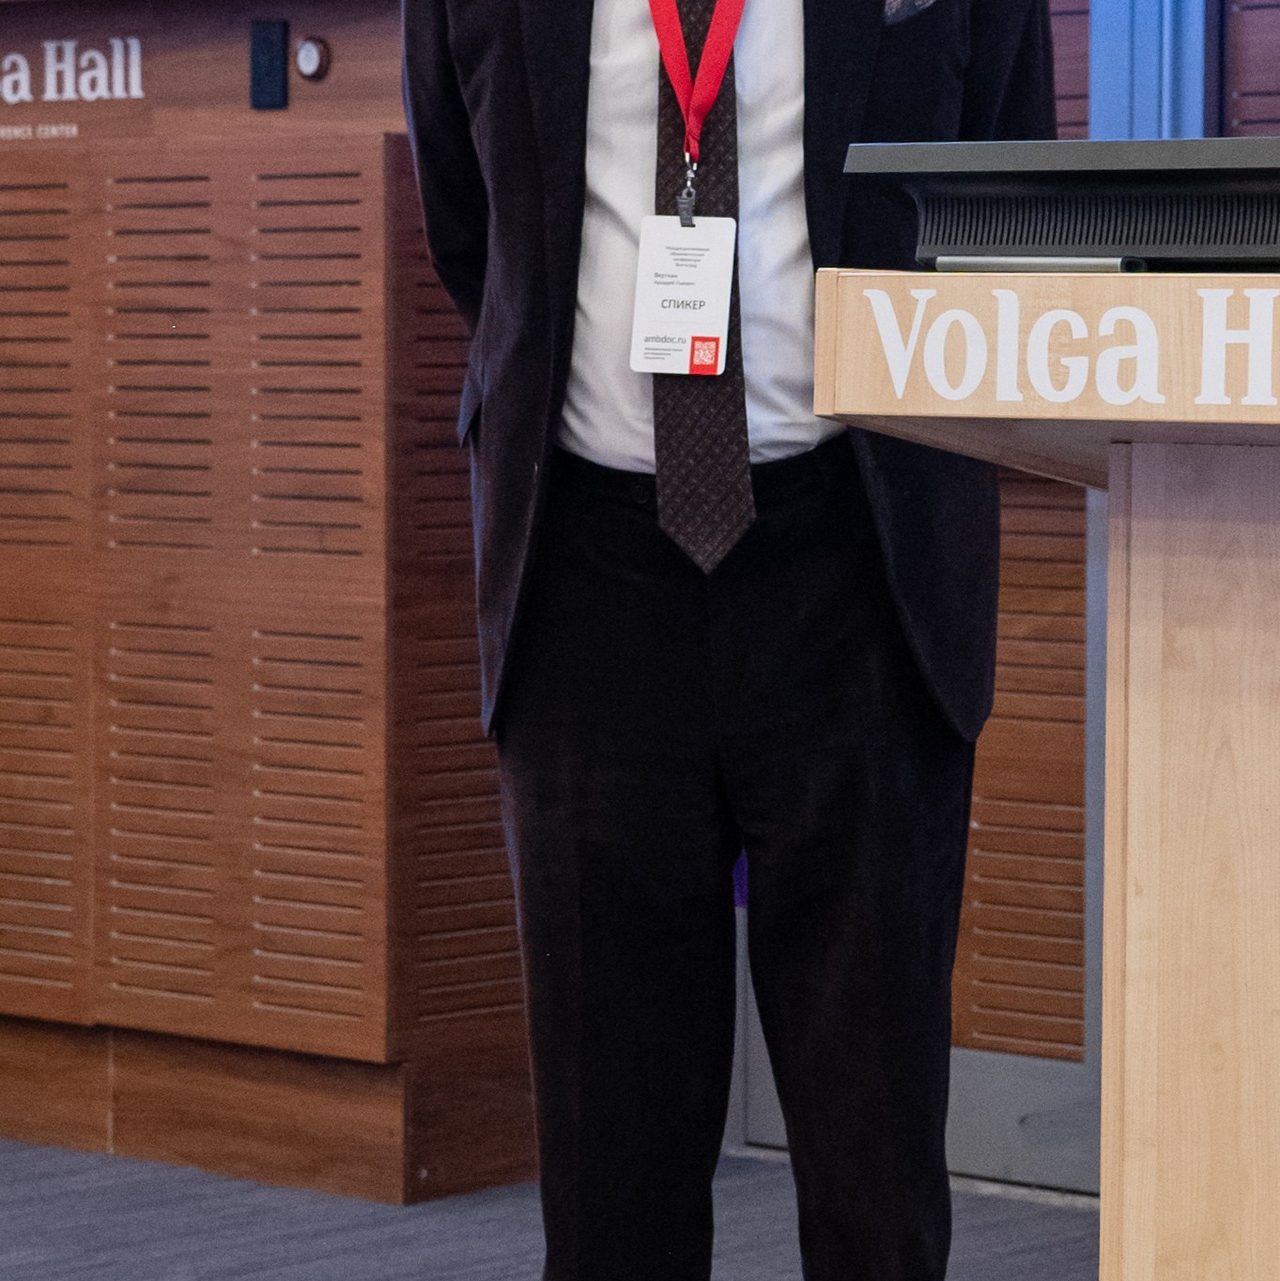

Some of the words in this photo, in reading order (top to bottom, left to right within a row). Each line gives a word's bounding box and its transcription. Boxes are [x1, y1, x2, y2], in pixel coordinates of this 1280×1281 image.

[42, 37, 145, 101] Hall
[661, 298, 706, 310] СПИКЕР
[644, 335, 686, 344] ambdoc.ru
[863, 288, 1165, 406] Volga
